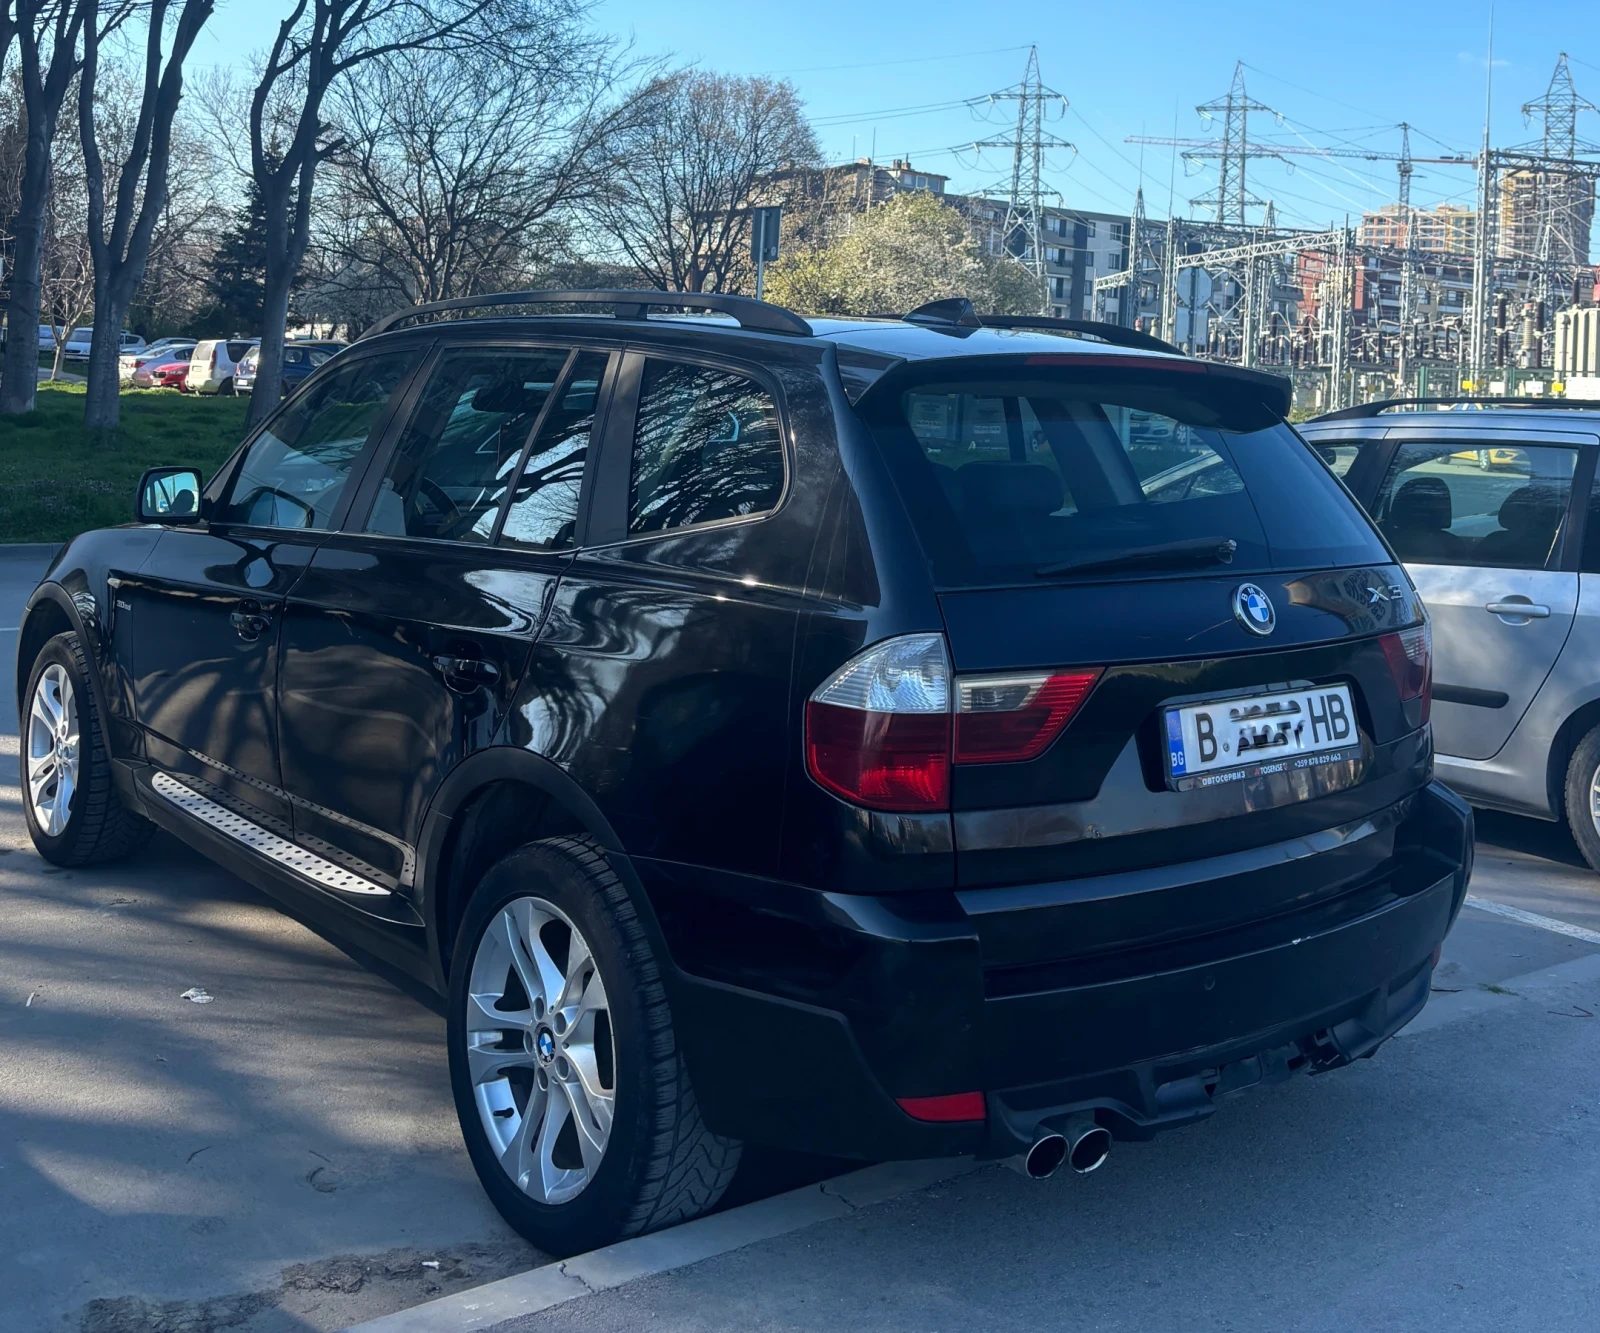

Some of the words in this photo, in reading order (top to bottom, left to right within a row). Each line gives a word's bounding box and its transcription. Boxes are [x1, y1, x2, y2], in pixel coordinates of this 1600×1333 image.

[1366, 584, 1403, 603] X3
[1307, 693, 1350, 744] HB
[1171, 751, 1185, 767] BG
[1330, 752, 1342, 762] 663
